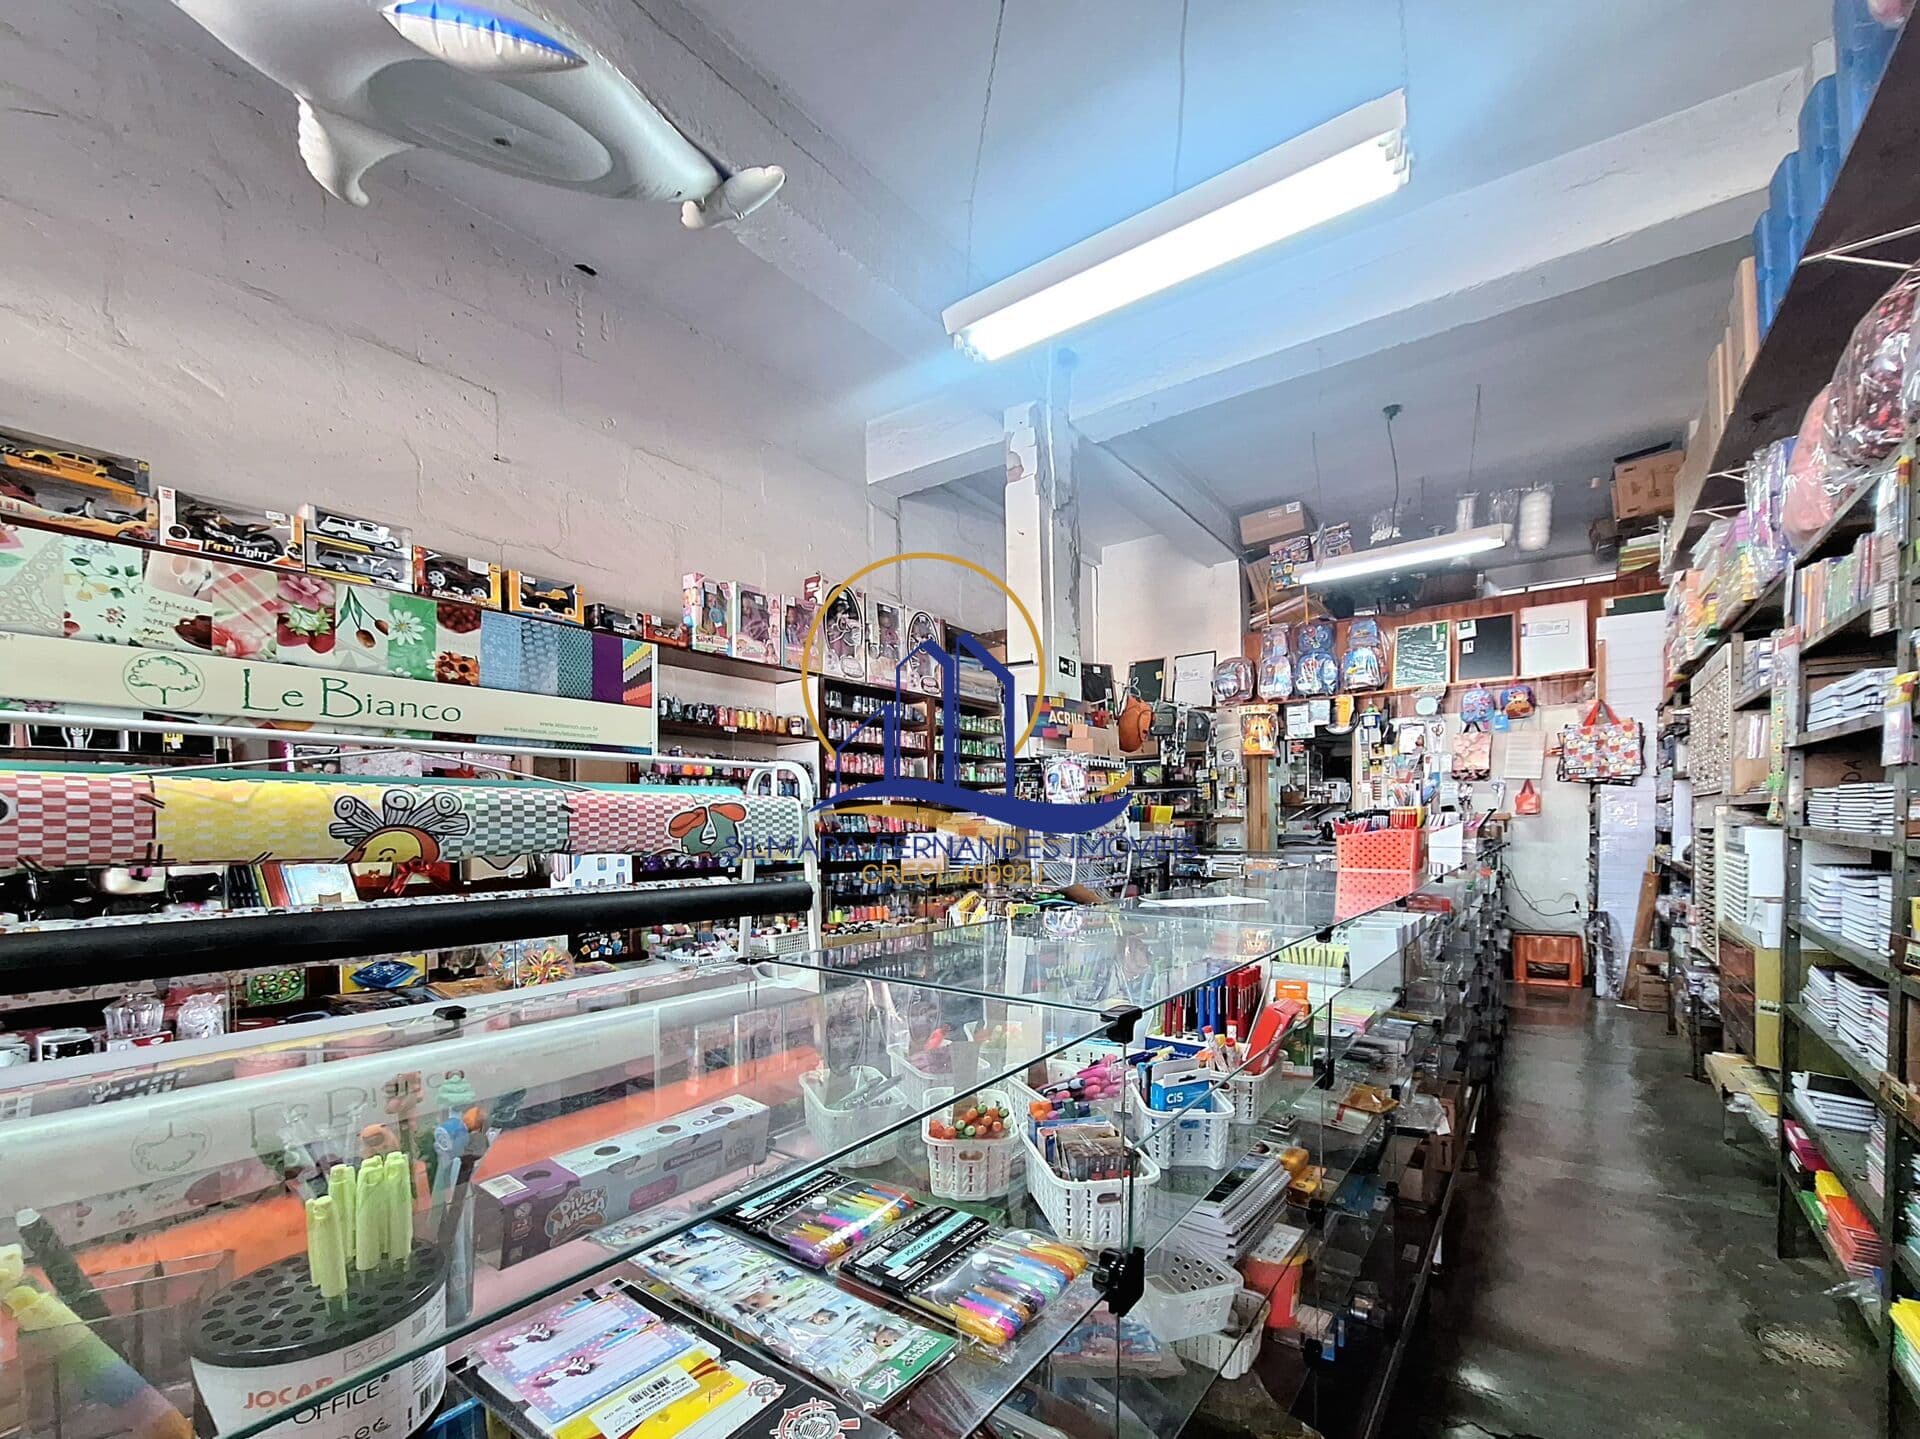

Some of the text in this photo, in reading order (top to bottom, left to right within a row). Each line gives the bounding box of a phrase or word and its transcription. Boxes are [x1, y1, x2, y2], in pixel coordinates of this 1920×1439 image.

[241, 668, 462, 722] Le Bianco
[553, 1196, 605, 1236] MASSA
